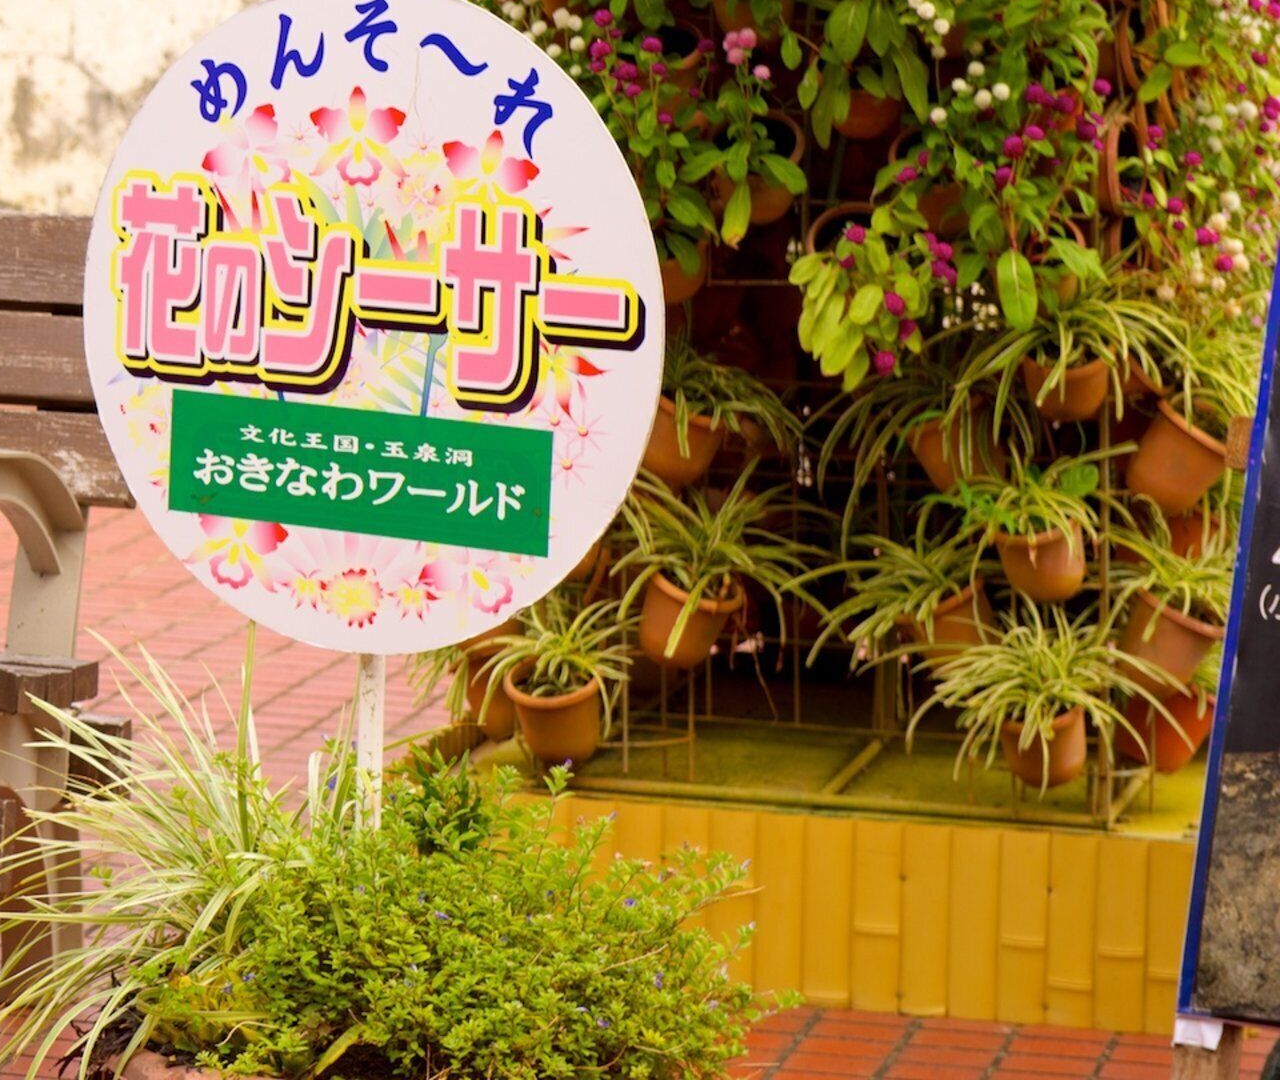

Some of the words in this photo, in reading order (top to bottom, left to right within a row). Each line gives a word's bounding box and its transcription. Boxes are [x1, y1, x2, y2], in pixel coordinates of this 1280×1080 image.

[112, 170, 646, 412] 花のシーサー
[240, 424, 473, 467] 文化王国・玉泉洞
[193, 448, 526, 520] おきなわワールド
